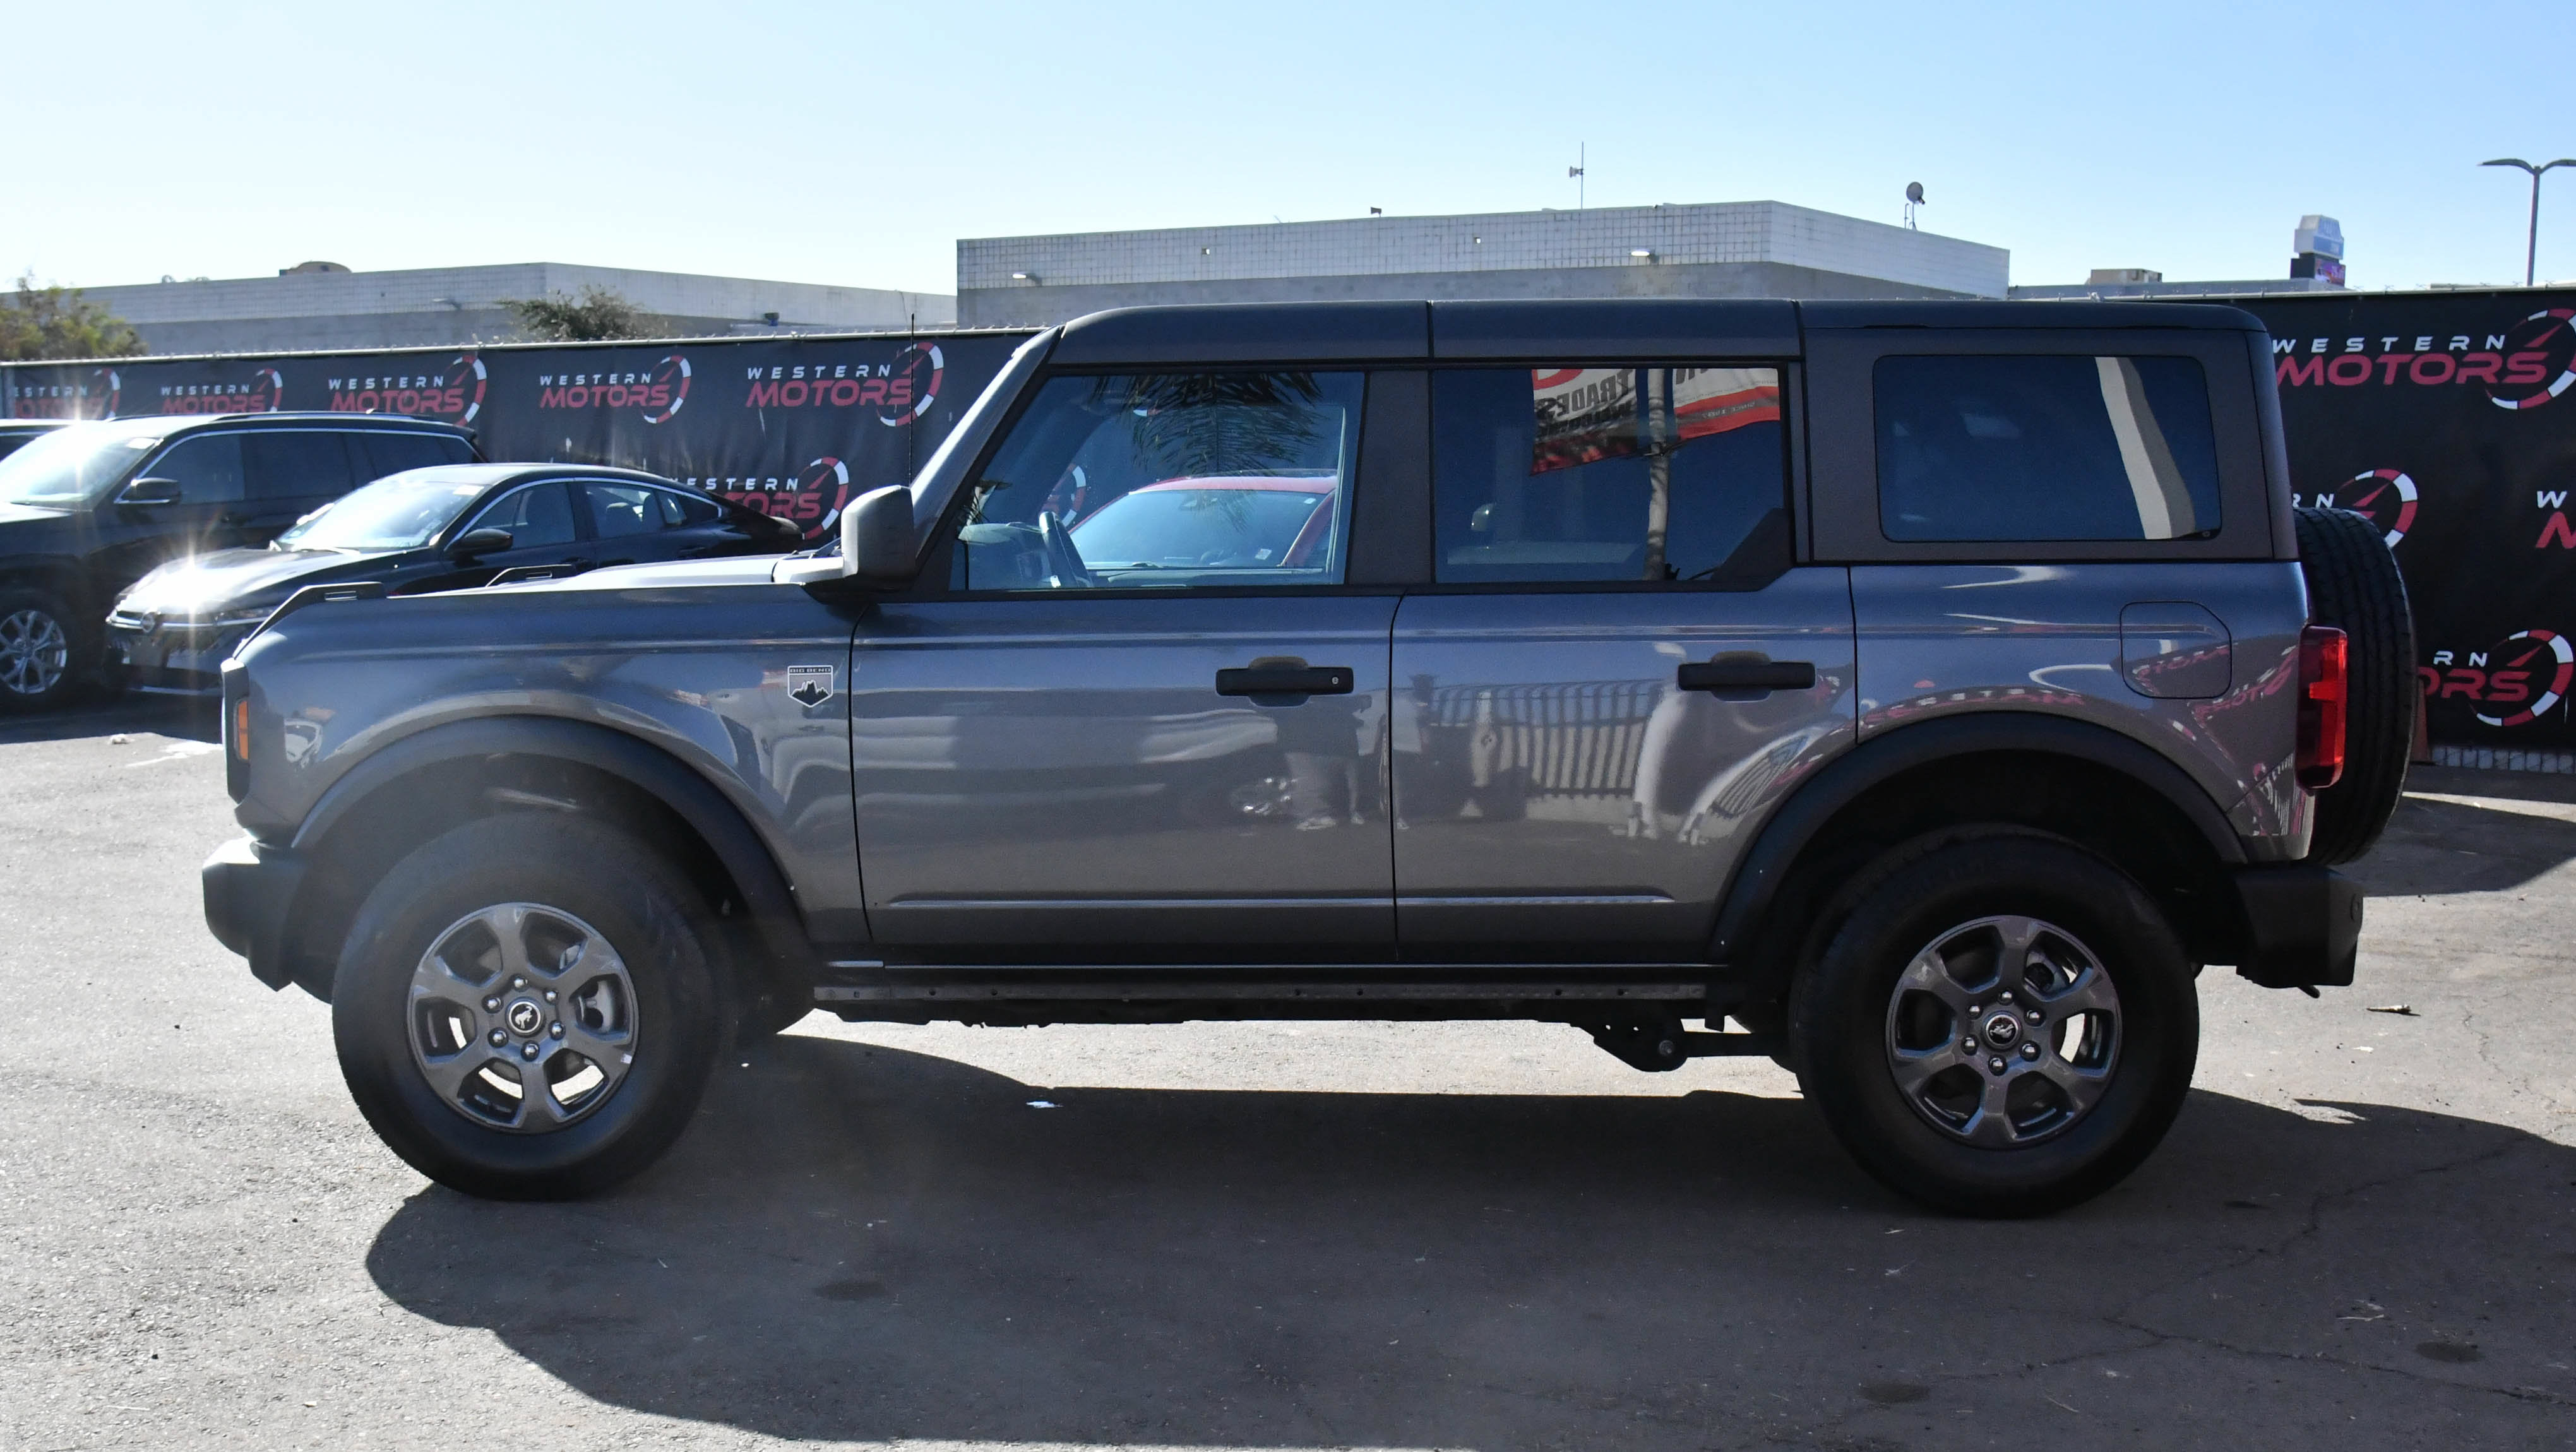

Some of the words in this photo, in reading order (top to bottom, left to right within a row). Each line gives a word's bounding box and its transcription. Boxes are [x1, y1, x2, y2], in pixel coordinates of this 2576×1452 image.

[2273, 334, 2505, 354] WESTERN
[748, 364, 891, 379] WESTERN
[2277, 352, 2548, 386] MOTORS
[328, 376, 444, 390] WESTERN
[540, 373, 652, 386] WESTERN
[14, 386, 88, 397] ESTERN
[161, 384, 250, 396] WESTERN
[540, 384, 671, 408] MOTORS
[746, 378, 915, 407] MOTORS
[162, 395, 266, 414] MOTORS
[330, 388, 465, 414] MOTORS
